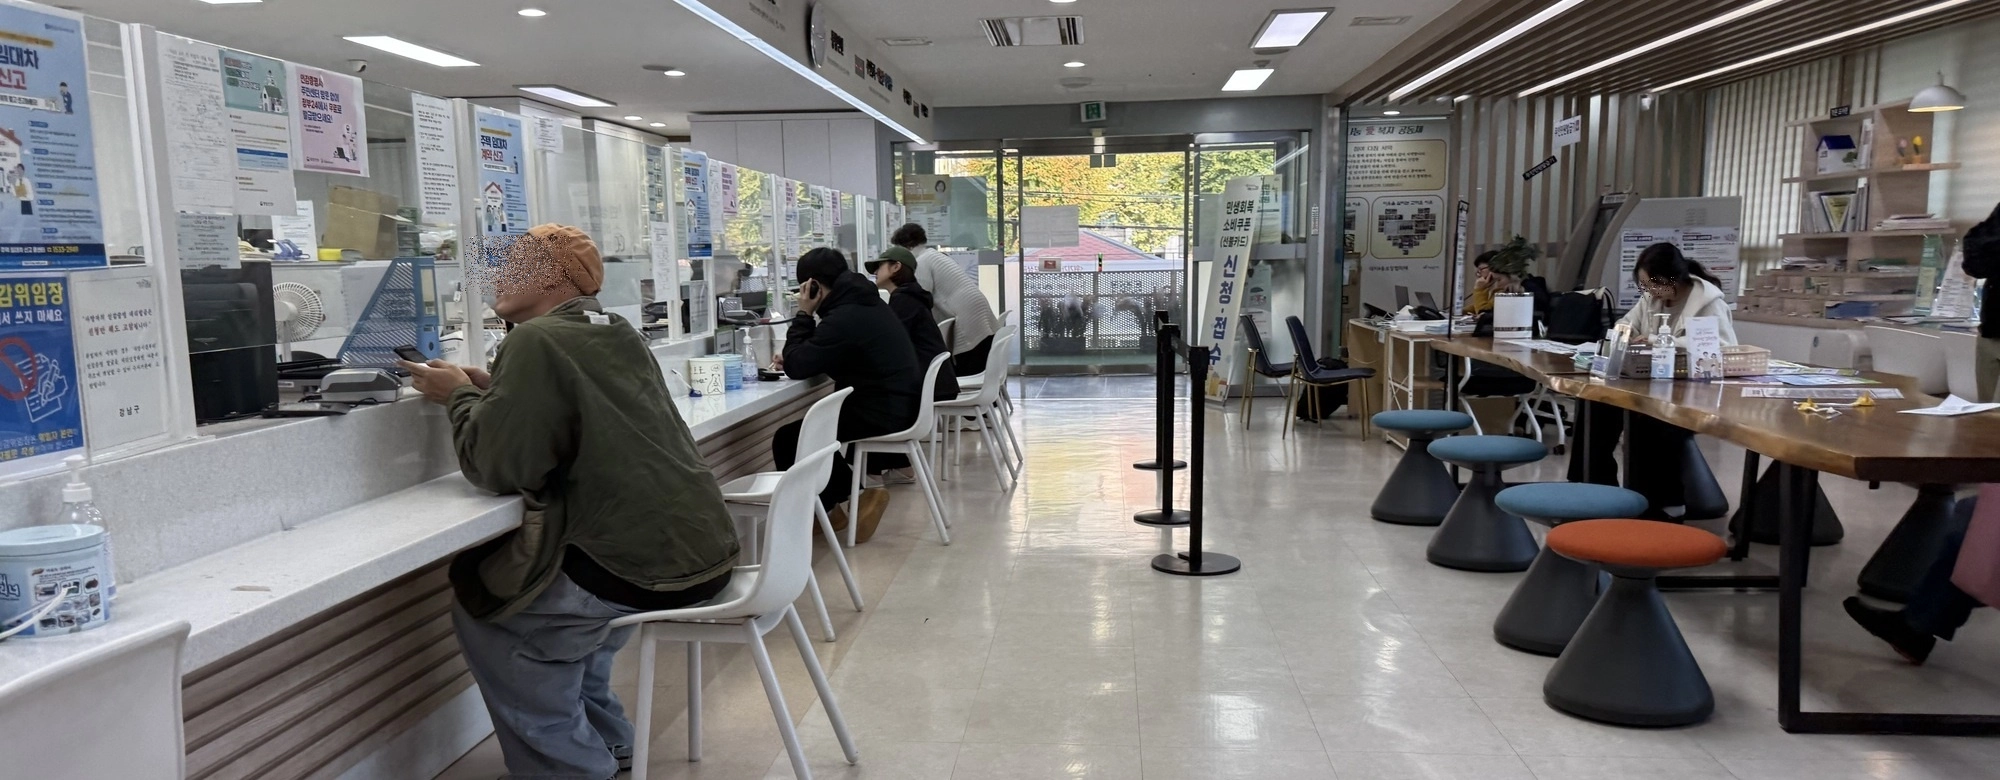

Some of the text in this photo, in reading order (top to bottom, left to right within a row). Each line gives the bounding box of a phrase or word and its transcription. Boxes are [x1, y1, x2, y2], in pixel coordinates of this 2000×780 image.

[301, 86, 320, 98] 주민센터
[320, 91, 329, 100] 방문
[302, 98, 328, 112] 정부24에서
[480, 134, 507, 150] 주택 임대차
[493, 150, 503, 162] 신고
[1226, 200, 1254, 215] 민생회복
[1223, 217, 1251, 231] 소비쿠폰
[1220, 236, 1249, 248] (선불카드)
[15, 310, 33, 324] 쓰지
[37, 309, 63, 322] 마세요
